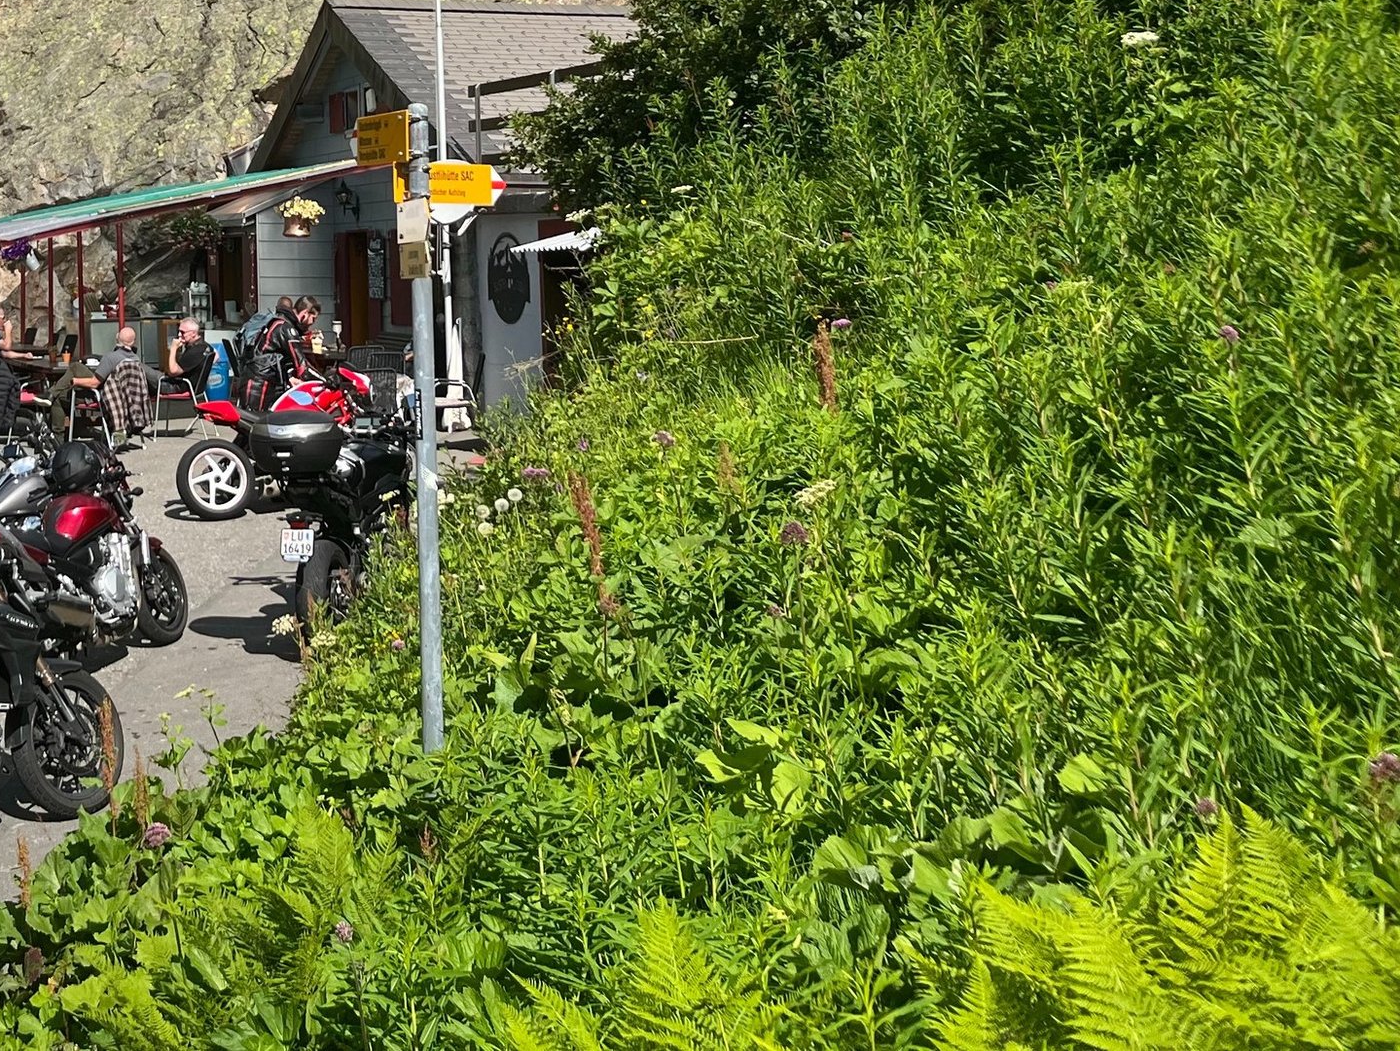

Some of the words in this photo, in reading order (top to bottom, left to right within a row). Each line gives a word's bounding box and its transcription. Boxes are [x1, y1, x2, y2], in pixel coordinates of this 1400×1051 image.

[461, 171, 474, 181] SAC
[291, 531, 304, 542] LU
[283, 543, 312, 554] 16419
